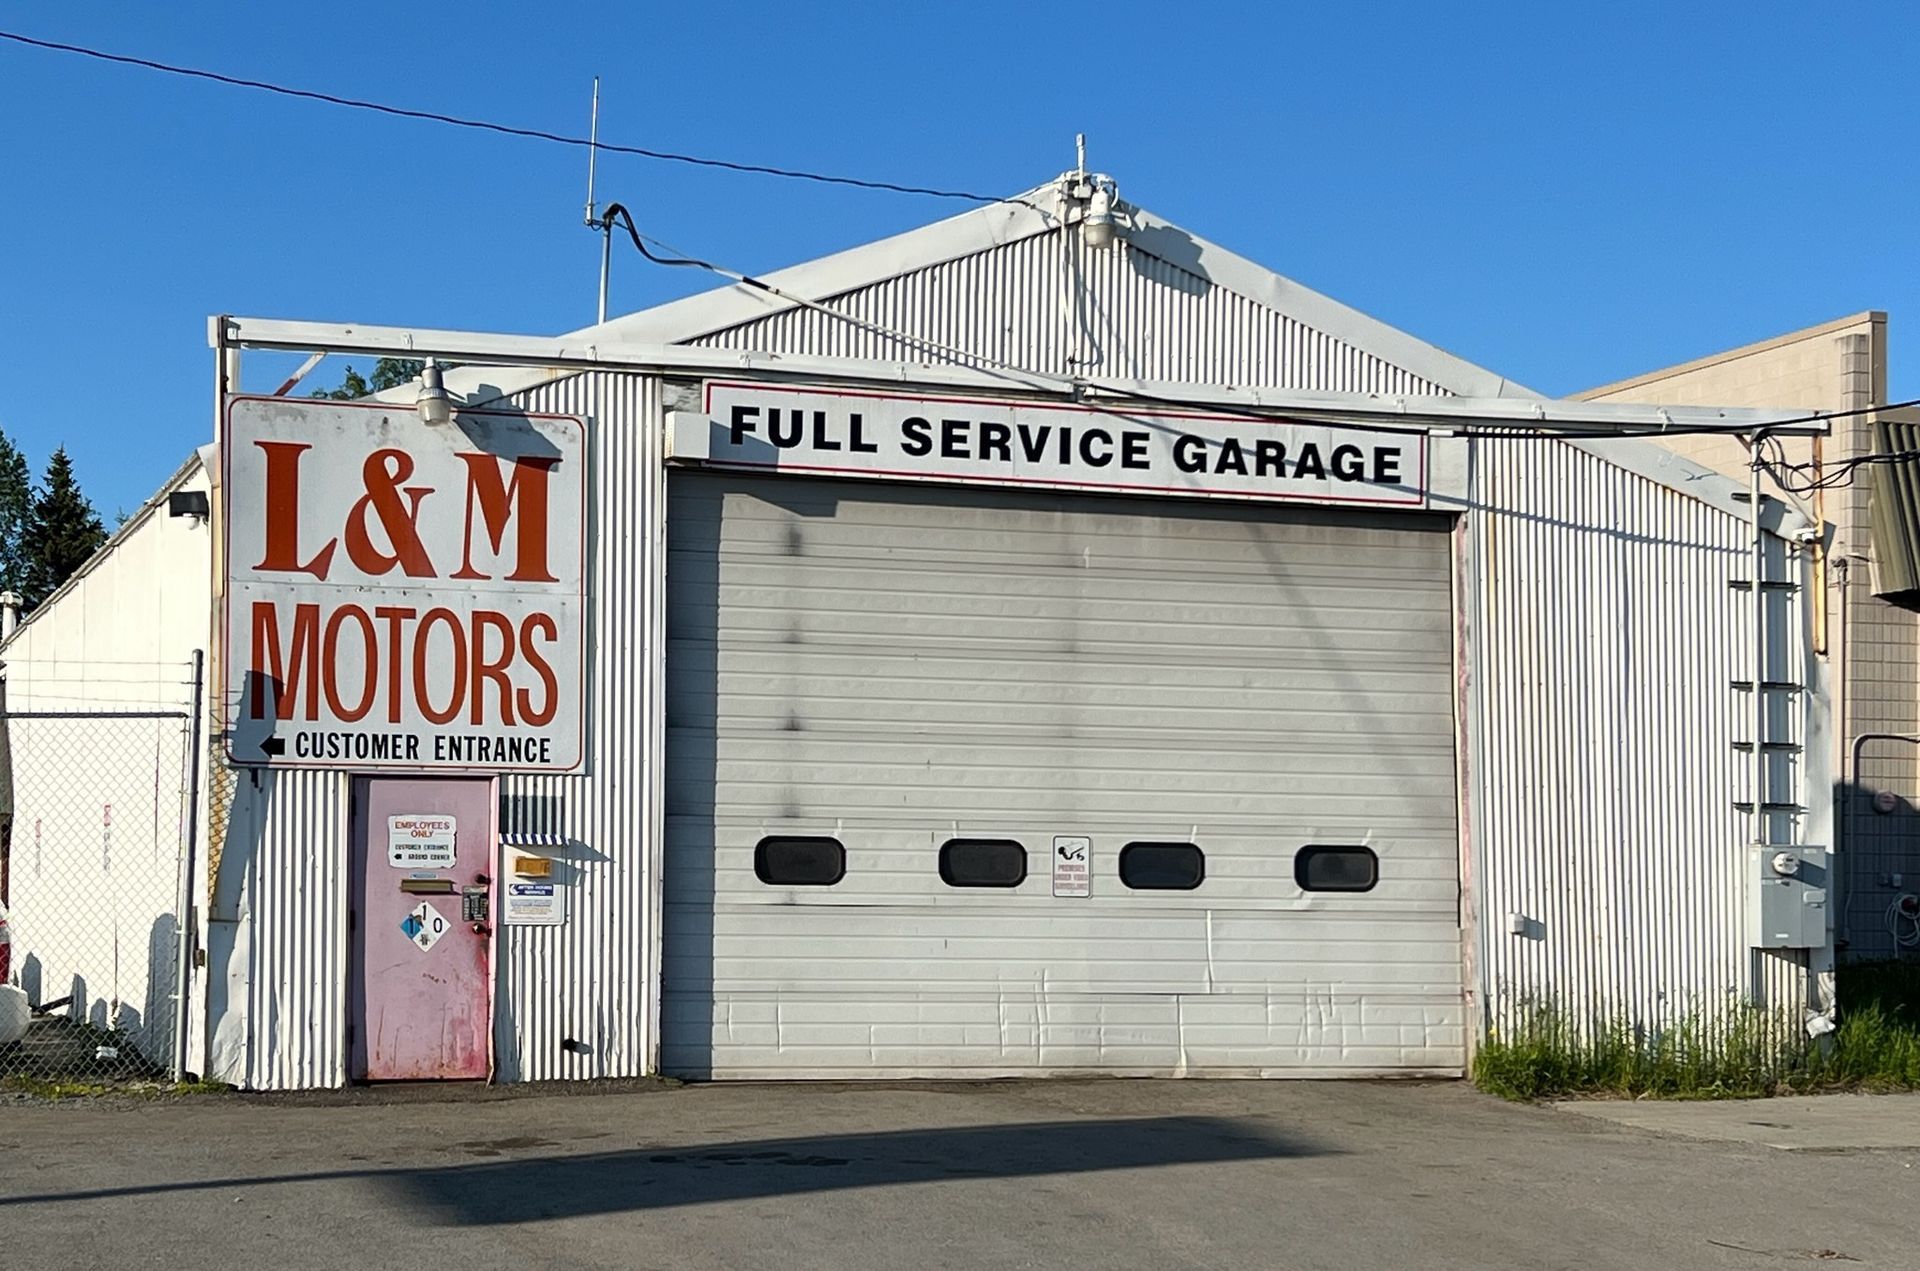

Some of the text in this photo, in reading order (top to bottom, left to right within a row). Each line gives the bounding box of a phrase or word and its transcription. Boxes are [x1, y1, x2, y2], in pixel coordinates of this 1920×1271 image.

[731, 405, 1402, 484] FULL SERVICE GARAGE
[252, 440, 564, 582] L&M
[251, 602, 558, 727] MOTORS
[295, 731, 551, 763] CUSTOMER ENTRANCE
[395, 821, 450, 830] EMPLOYEES
[410, 830, 434, 838] ONLY
[421, 905, 427, 921] 1
[433, 917, 443, 934] 0
